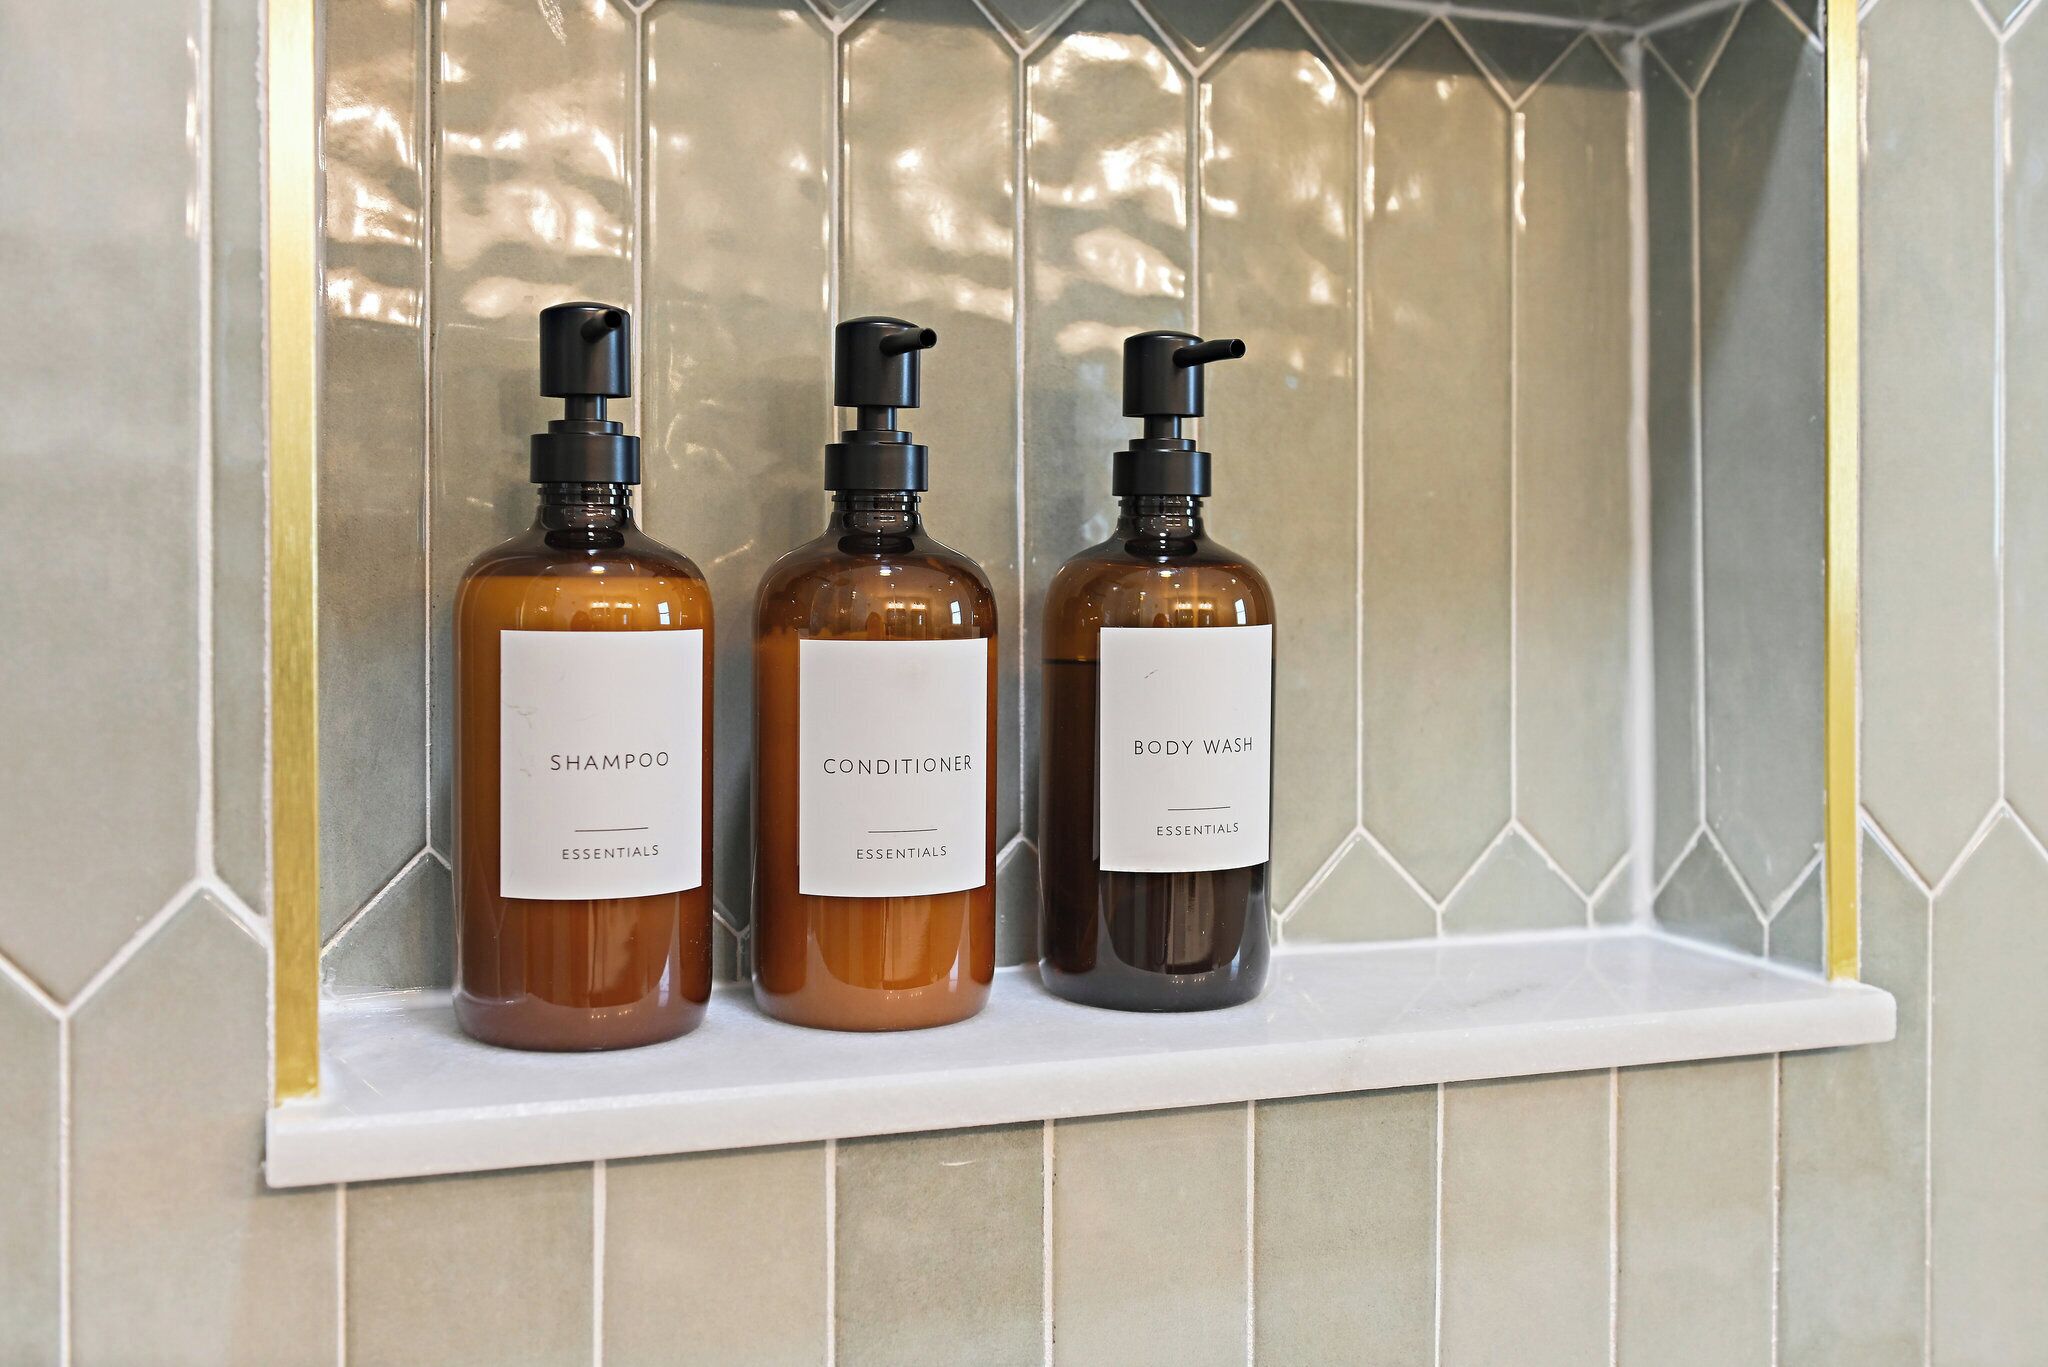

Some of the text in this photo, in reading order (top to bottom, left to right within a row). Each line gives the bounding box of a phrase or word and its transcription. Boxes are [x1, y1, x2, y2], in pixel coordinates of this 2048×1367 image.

[1134, 737, 1253, 755] BODY WASH
[550, 751, 670, 771] SHAMPOO
[823, 754, 973, 775] CONDITIONER
[1156, 822, 1239, 837] ESSENTIALS
[561, 844, 659, 861] ESSENTIALS
[856, 845, 947, 860] ESSENTIALS
